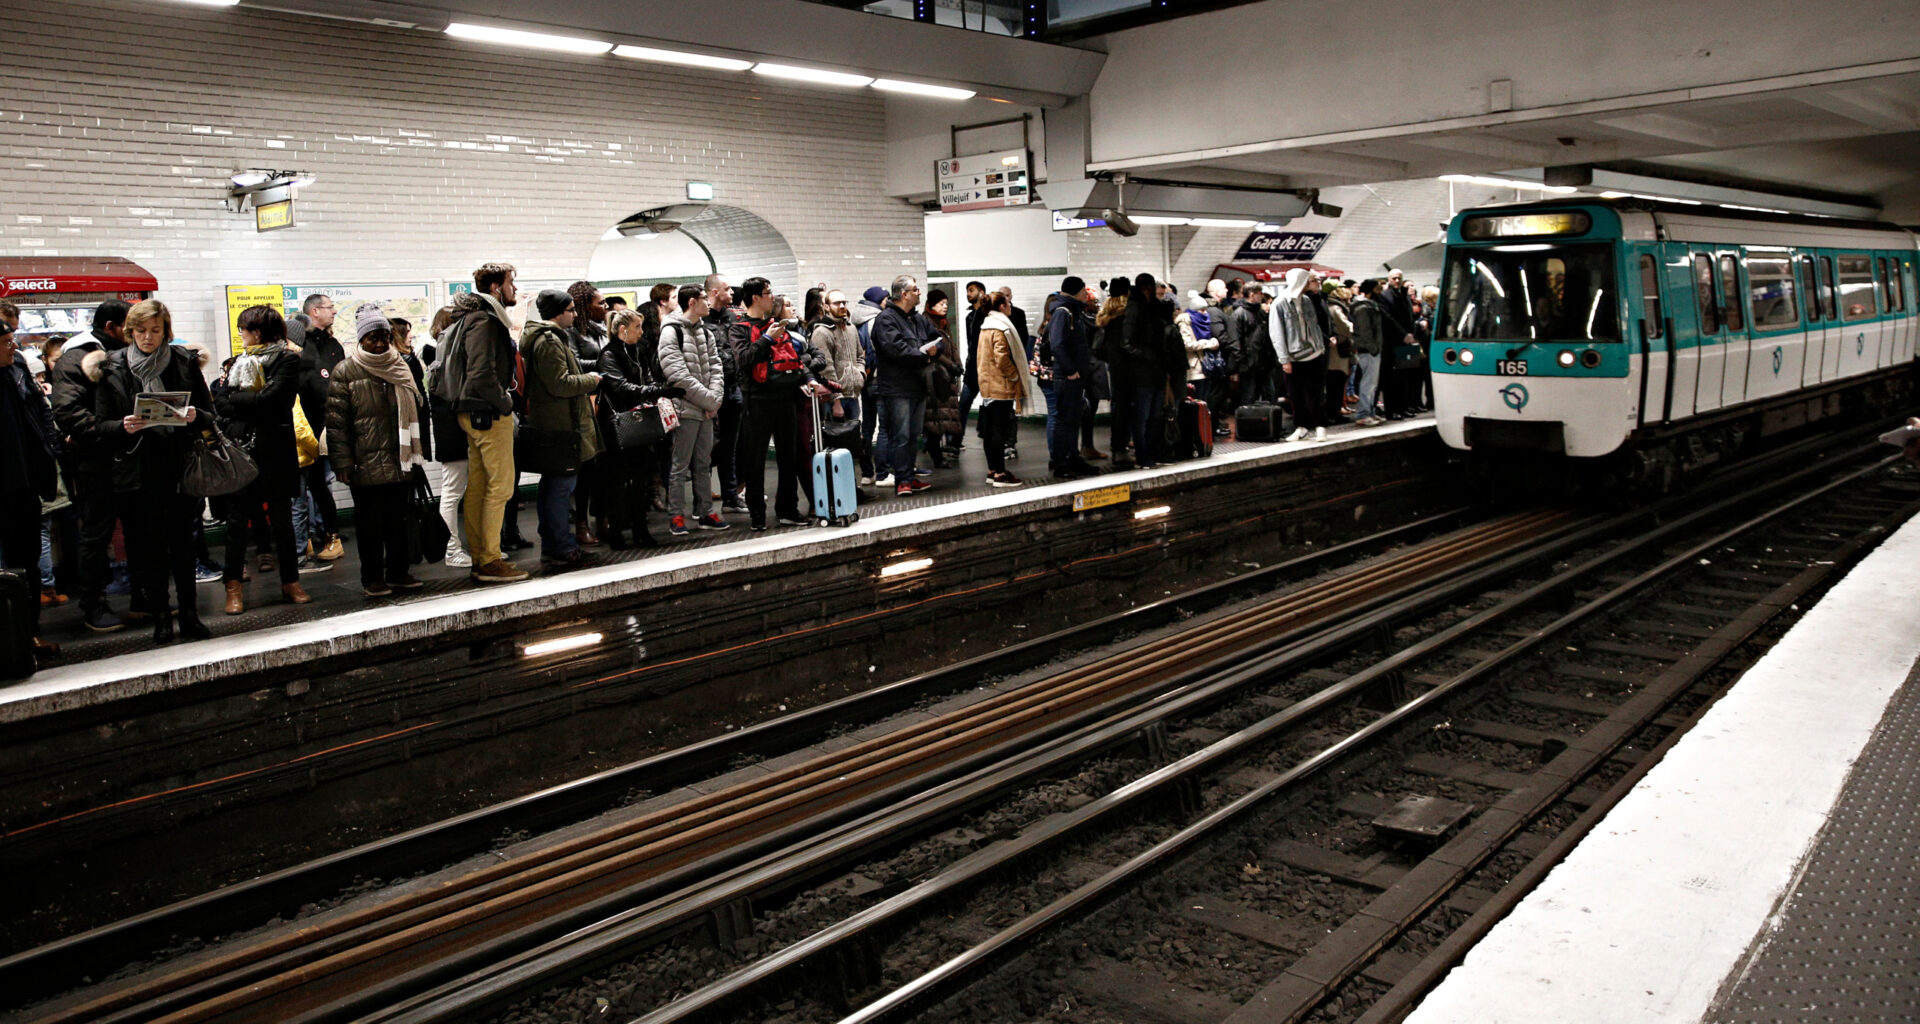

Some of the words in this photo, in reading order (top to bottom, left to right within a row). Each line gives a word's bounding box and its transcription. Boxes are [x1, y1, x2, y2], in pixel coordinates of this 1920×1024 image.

[941, 181, 954, 191] Ivry
[942, 192, 970, 204] Villejuif
[260, 211, 283, 225] Alarme
[1250, 235, 1281, 249] Gare
[1279, 235, 1297, 249] de
[1294, 235, 1322, 250] l'Est
[8, 279, 56, 290] selecta
[1498, 360, 1528, 375] 165
